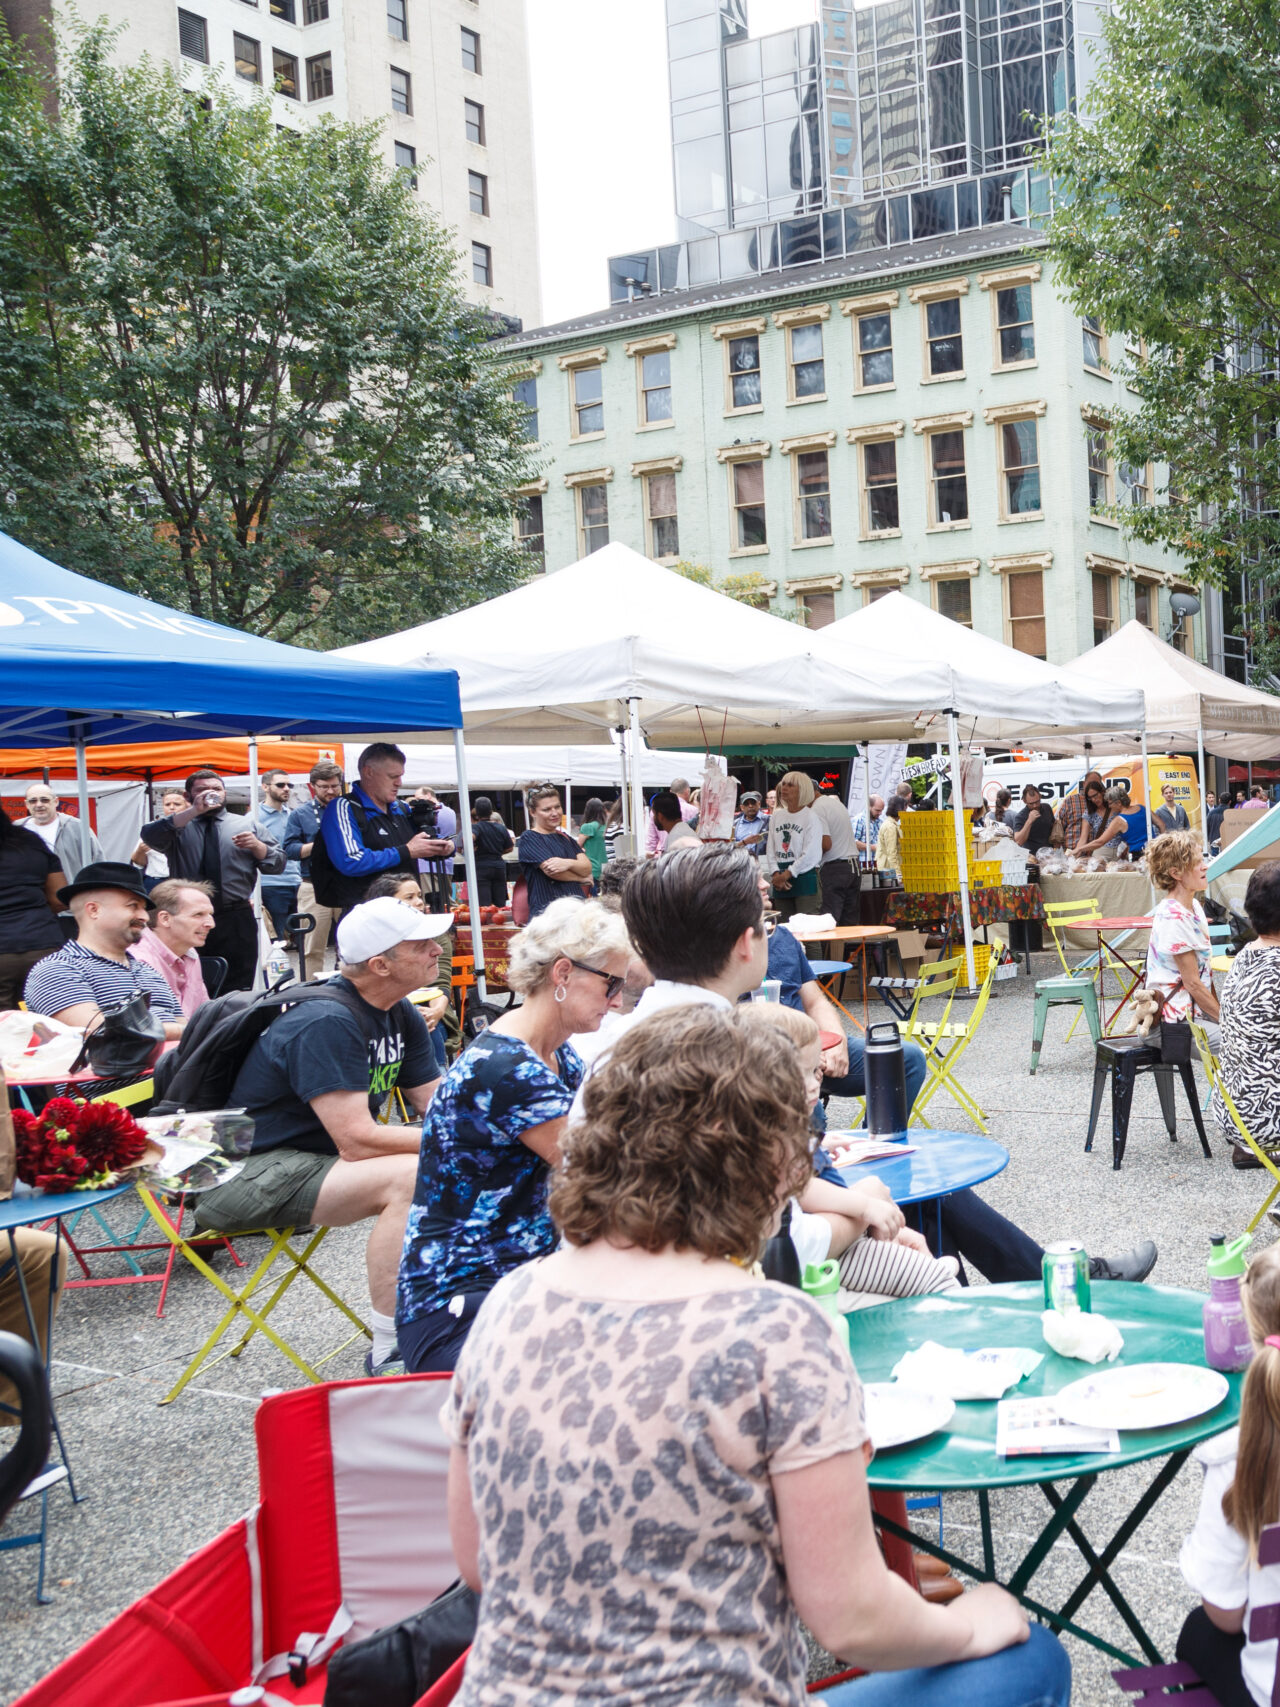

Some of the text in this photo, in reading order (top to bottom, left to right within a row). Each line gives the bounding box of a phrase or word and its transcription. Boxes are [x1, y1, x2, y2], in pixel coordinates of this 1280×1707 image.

[12, 596, 248, 644] PNC
[921, 757, 947, 775] BREAD
[1006, 781, 1070, 802] EST
